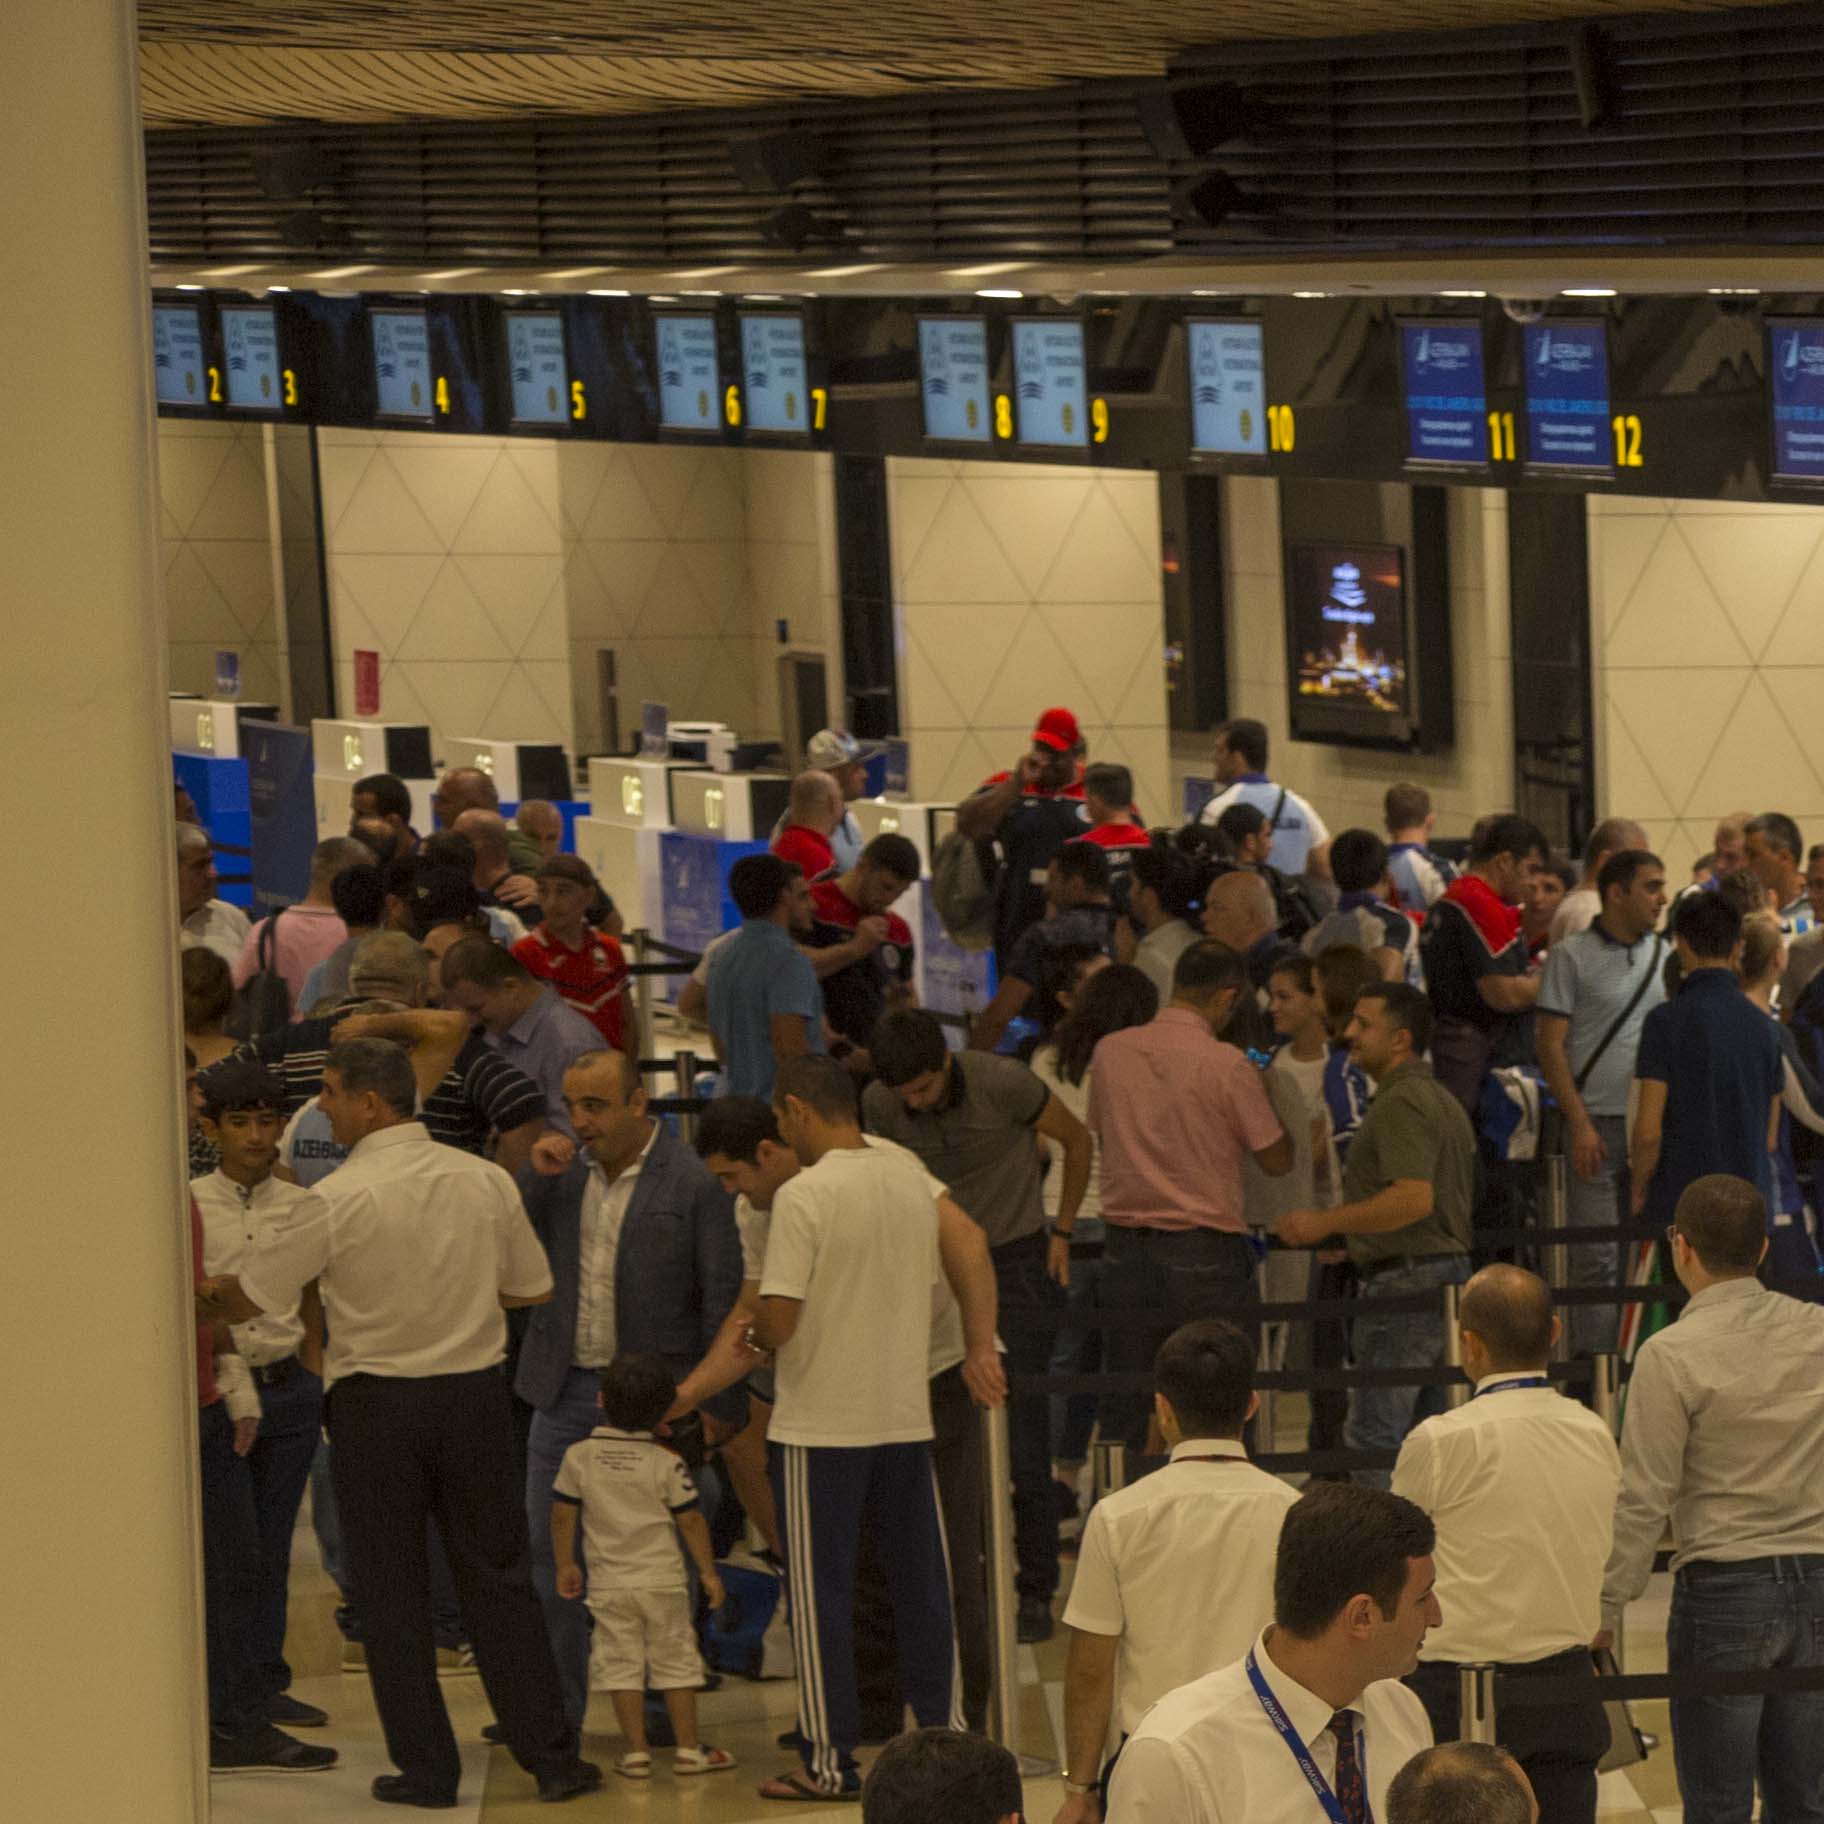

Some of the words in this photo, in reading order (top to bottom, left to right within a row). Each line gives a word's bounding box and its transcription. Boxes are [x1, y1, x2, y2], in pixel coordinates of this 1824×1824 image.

[208, 366, 221, 402] 2
[283, 368, 297, 405] 3
[435, 376, 449, 414] 4
[571, 380, 586, 419] 5
[725, 384, 740, 426] 6
[811, 388, 827, 430] 7
[994, 394, 1013, 439] 8
[1092, 397, 1109, 443] 9
[1266, 404, 1295, 452] 10
[1488, 411, 1515, 461] 11
[1612, 415, 1644, 467] 12
